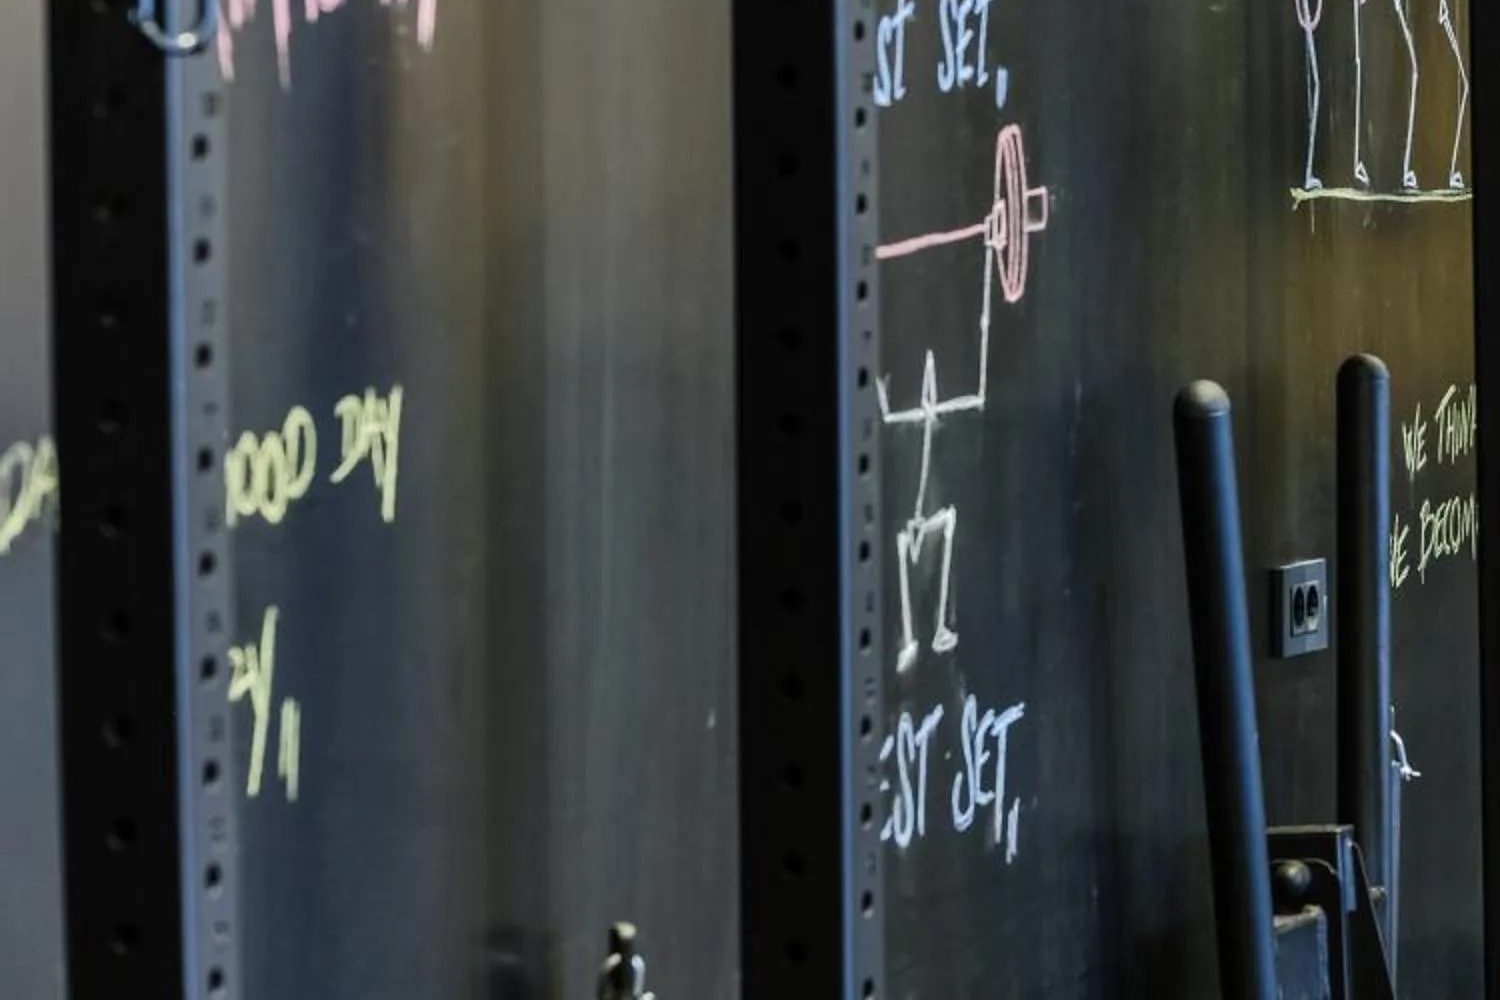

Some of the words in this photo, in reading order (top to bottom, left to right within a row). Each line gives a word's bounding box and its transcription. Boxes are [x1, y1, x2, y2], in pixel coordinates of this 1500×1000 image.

[224, 405, 317, 526] OOD
[1402, 402, 1427, 482] WE
[1418, 495, 1479, 585] BECOM
